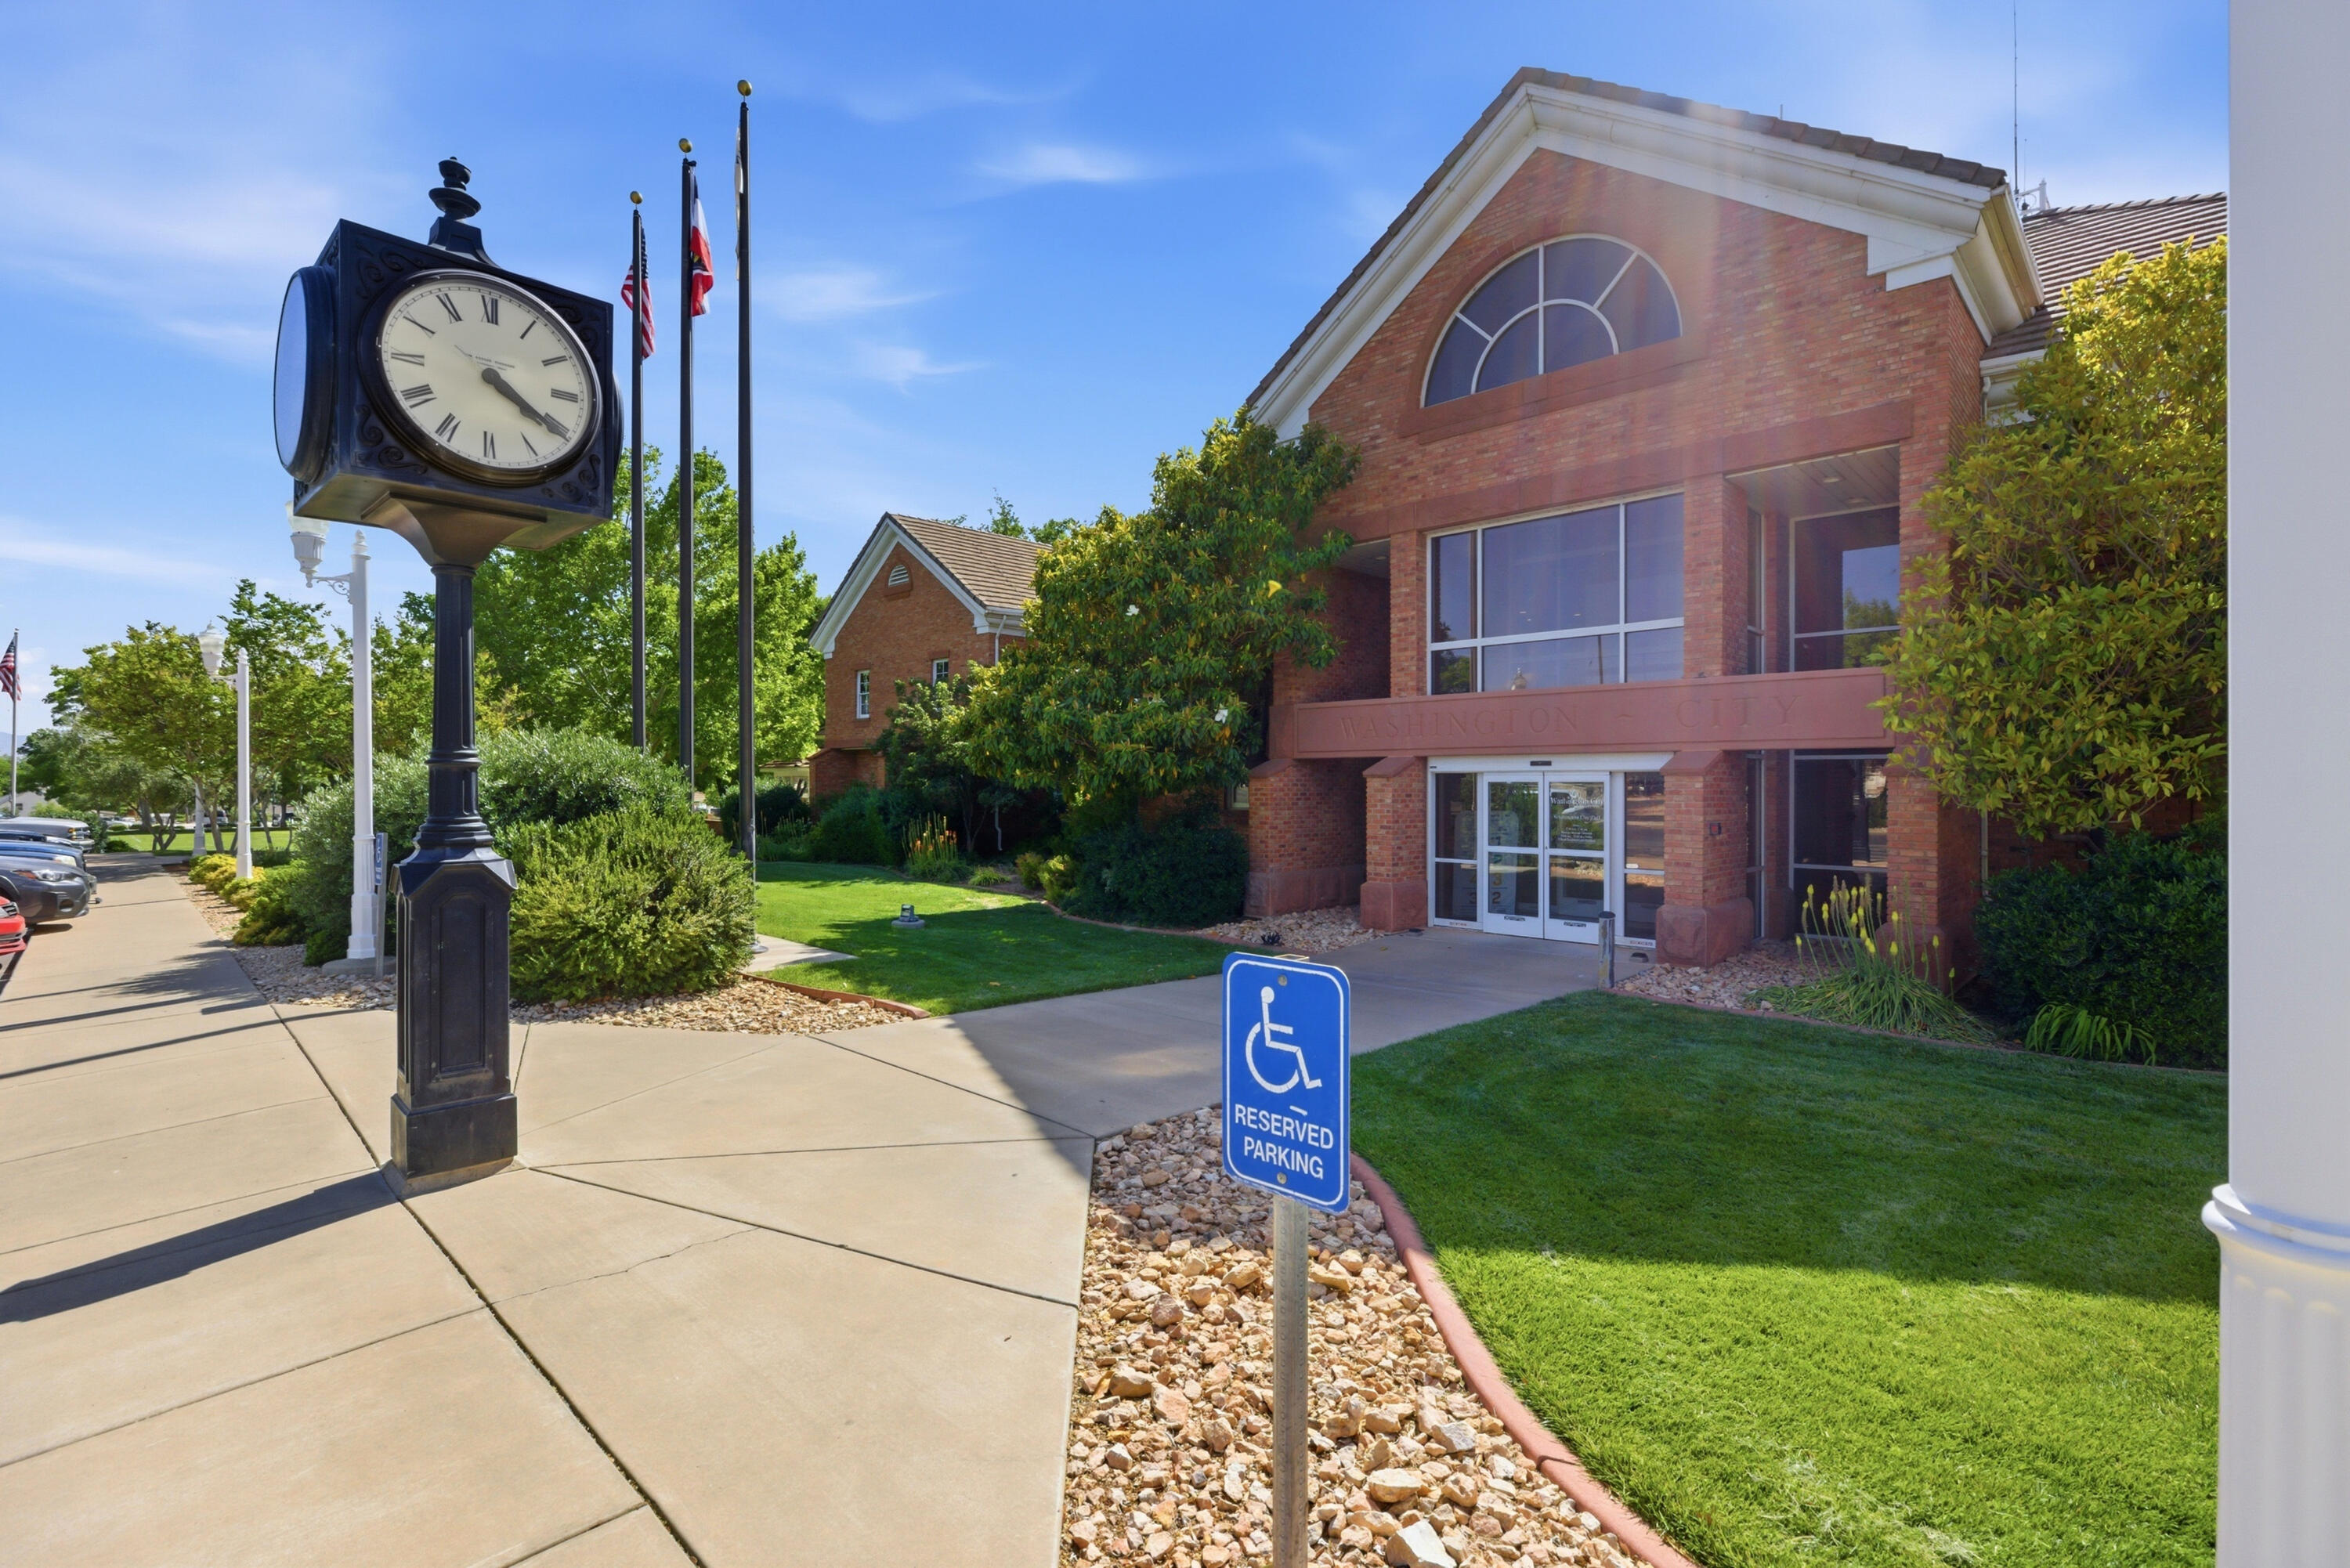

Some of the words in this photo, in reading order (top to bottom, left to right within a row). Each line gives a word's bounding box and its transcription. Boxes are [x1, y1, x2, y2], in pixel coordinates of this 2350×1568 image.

[480, 294, 500, 326] XII
[541, 355, 569, 367] II
[551, 388, 579, 403] III
[1340, 706, 1581, 740] WASHINGTON
[1676, 695, 1802, 728] CITY
[1235, 1104, 1334, 1149] RESERVED
[1243, 1136, 1324, 1180] PARKING
